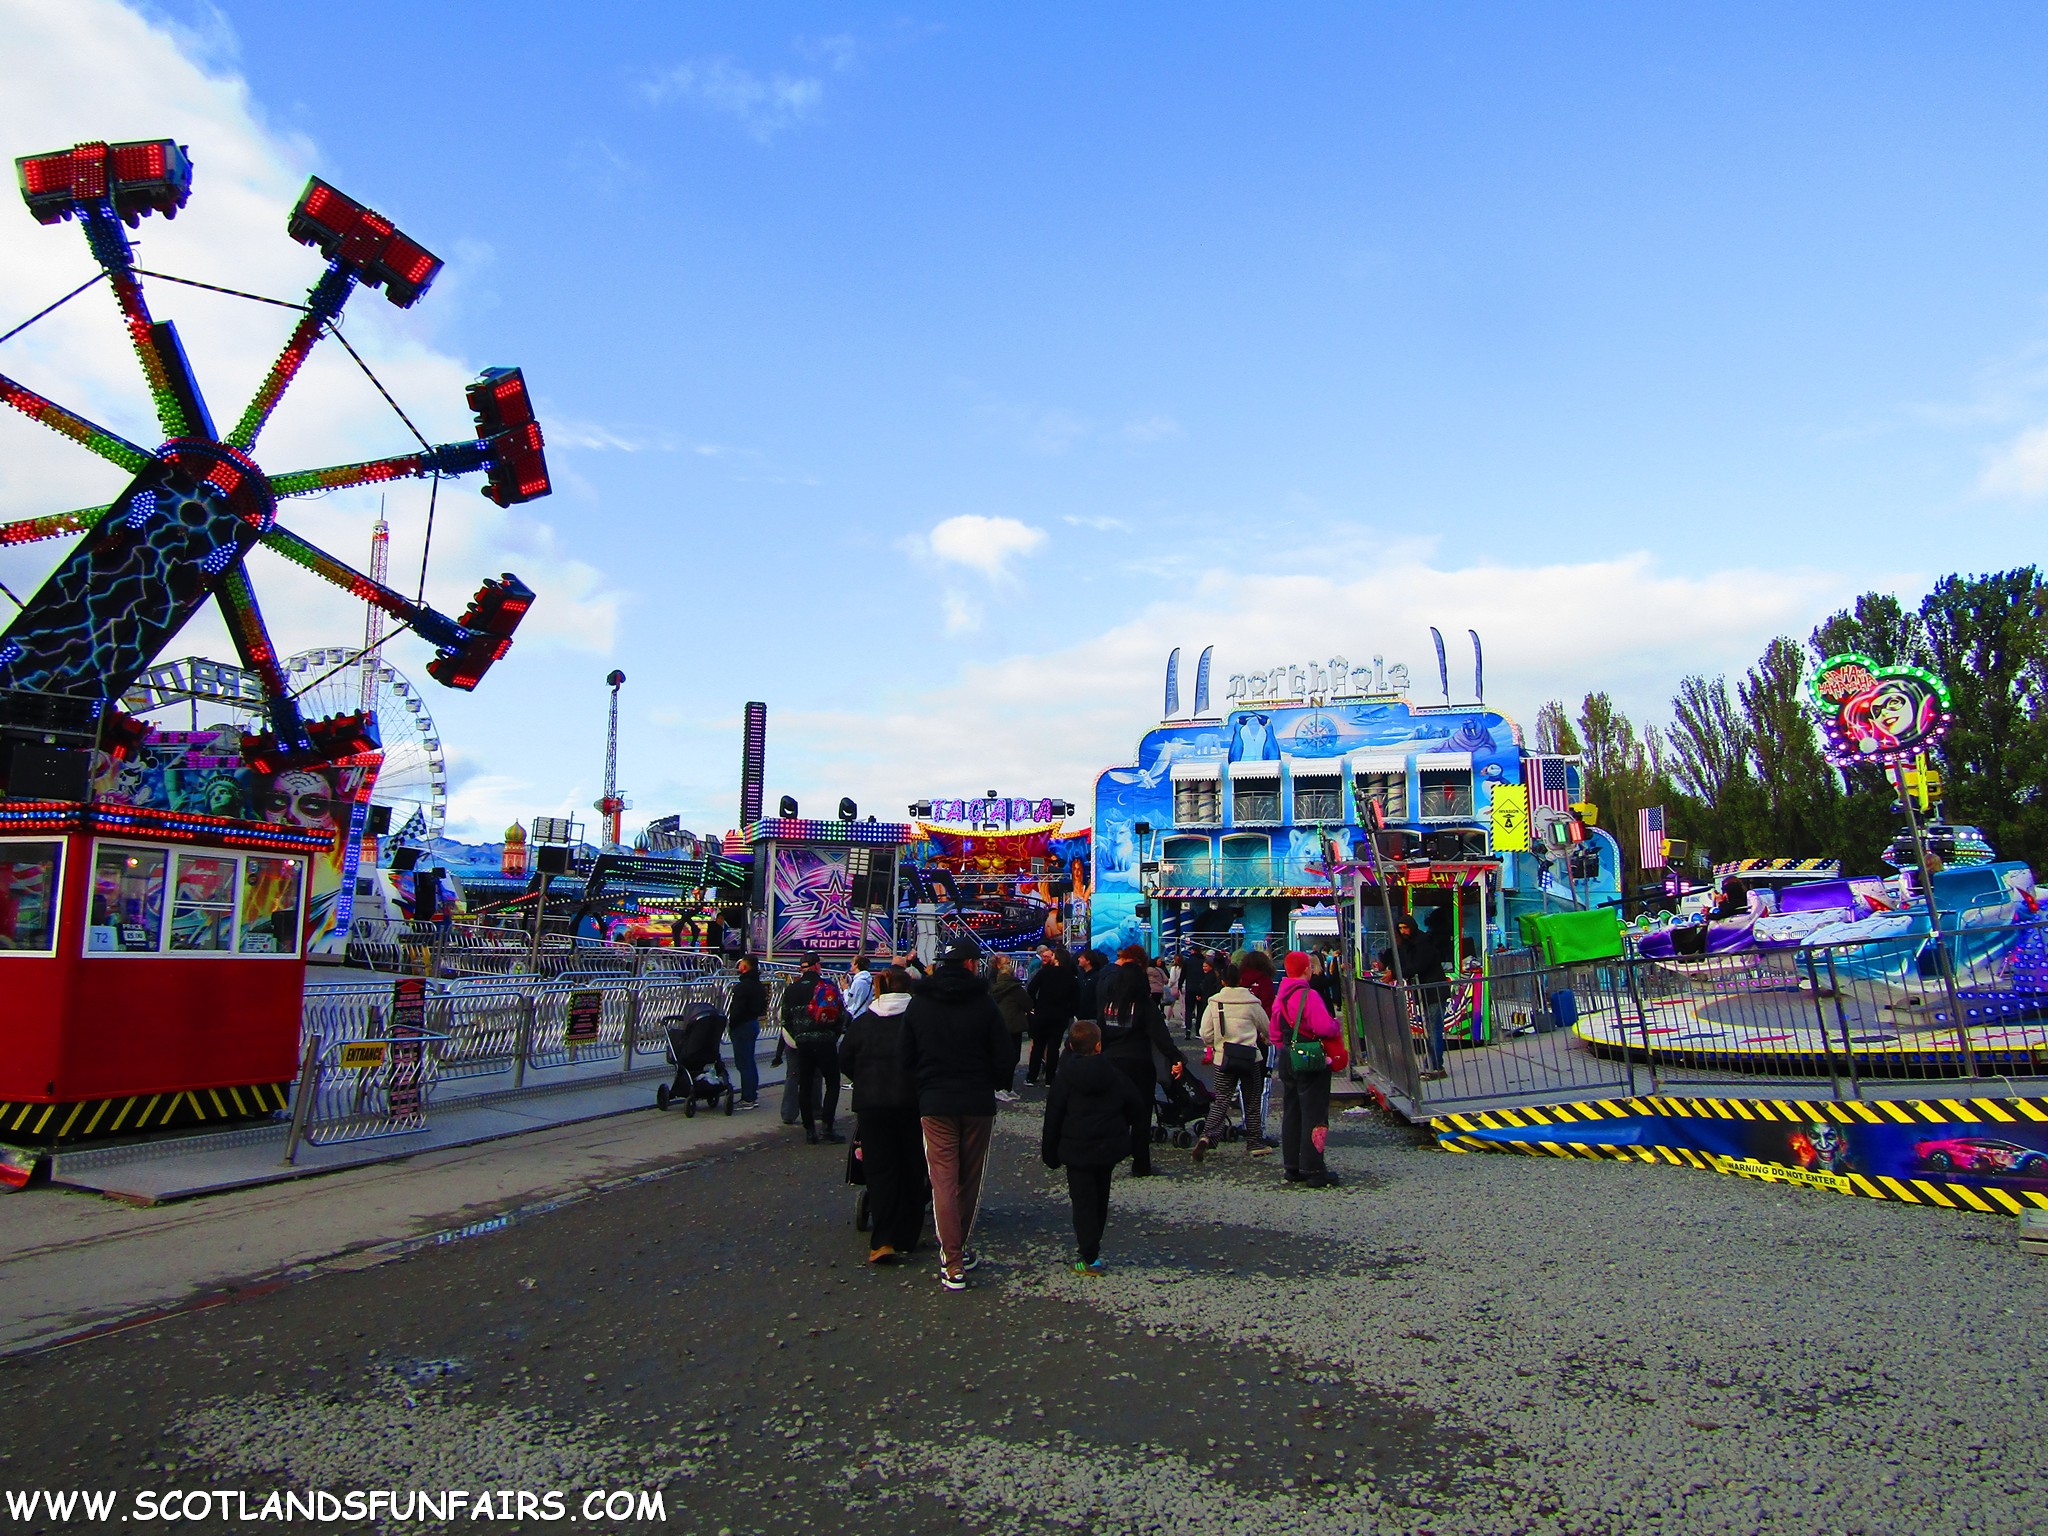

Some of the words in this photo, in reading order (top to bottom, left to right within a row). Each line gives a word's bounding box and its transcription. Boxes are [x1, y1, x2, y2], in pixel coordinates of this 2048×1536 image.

[931, 798, 1052, 823] TAGADA
[95, 932, 108, 943] T2
[816, 930, 852, 938] SUPER
[346, 1047, 383, 1061] ENTRANCE
[1728, 1162, 1769, 1174] WARNING
[1771, 1168, 1785, 1177] DO
[1786, 1170, 1804, 1180] NOT
[1806, 1174, 1836, 1185] ENTER
